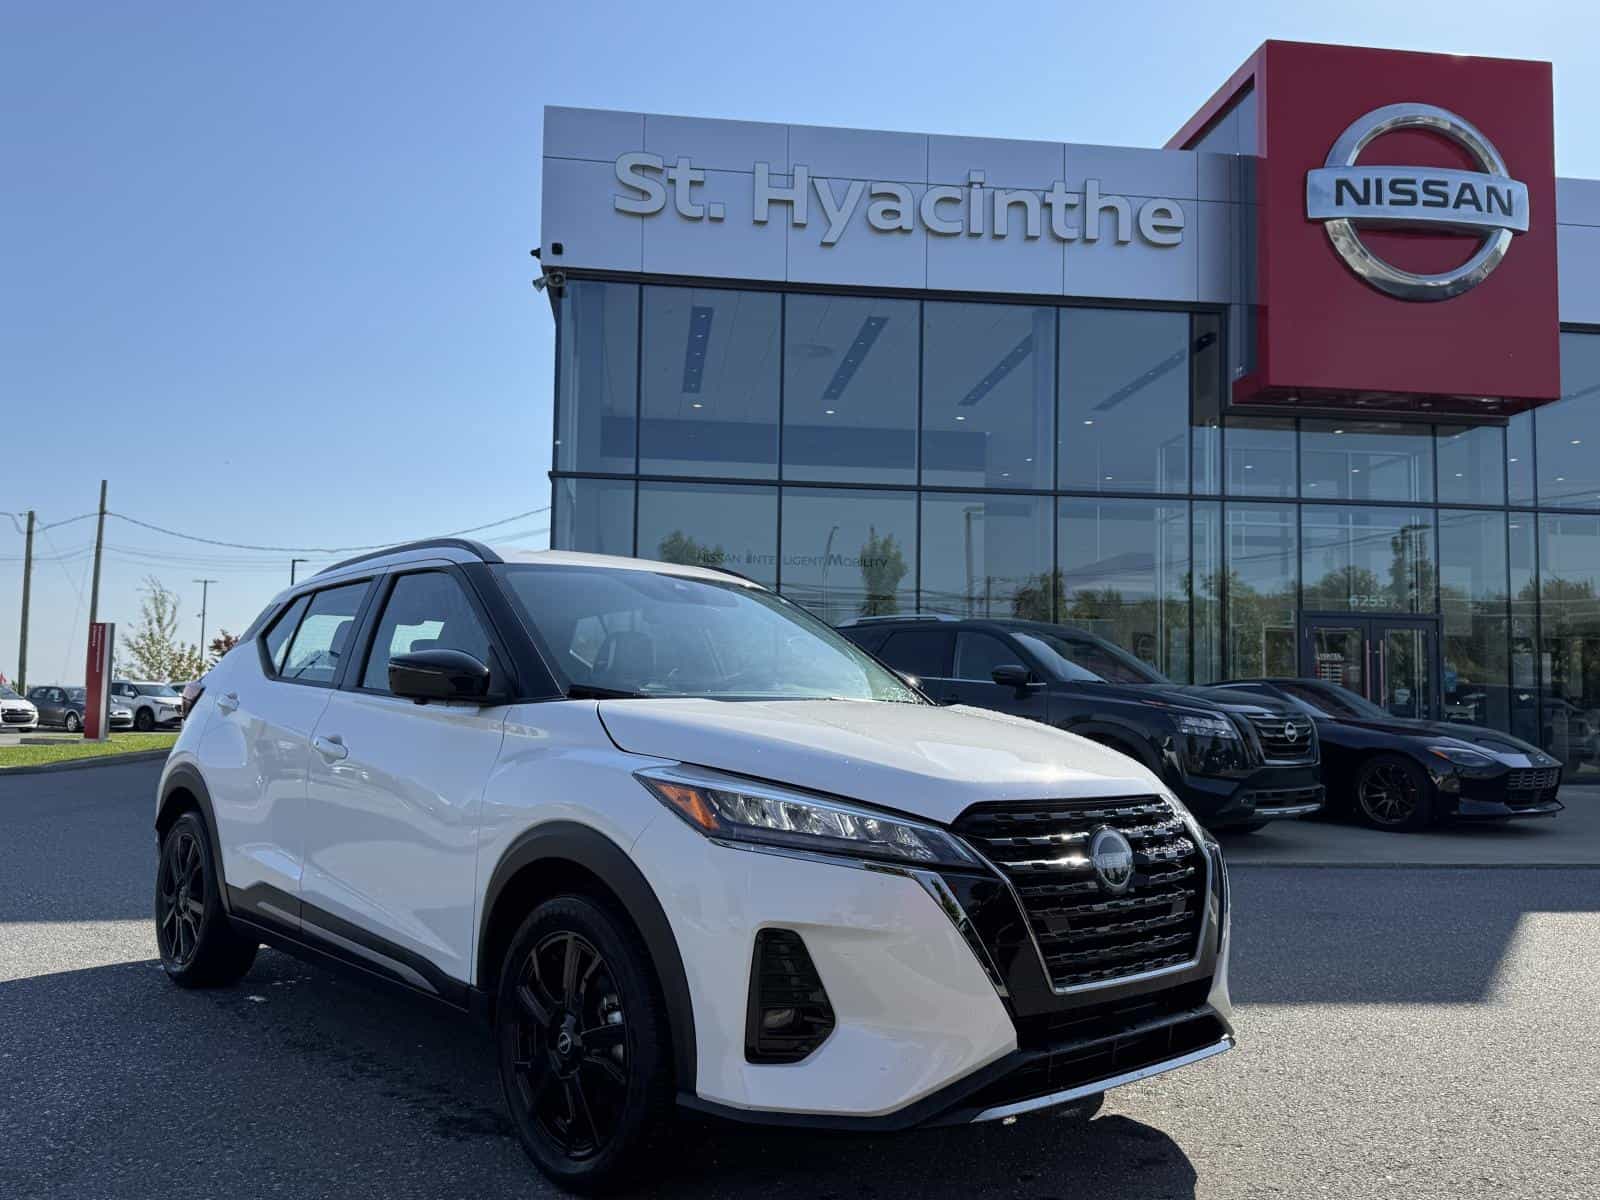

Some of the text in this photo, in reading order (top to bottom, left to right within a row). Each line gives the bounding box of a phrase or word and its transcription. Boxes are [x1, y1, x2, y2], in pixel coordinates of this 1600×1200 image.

[613, 151, 1185, 246] St. Hyacinthe
[1335, 178, 1512, 216] NISSAN
